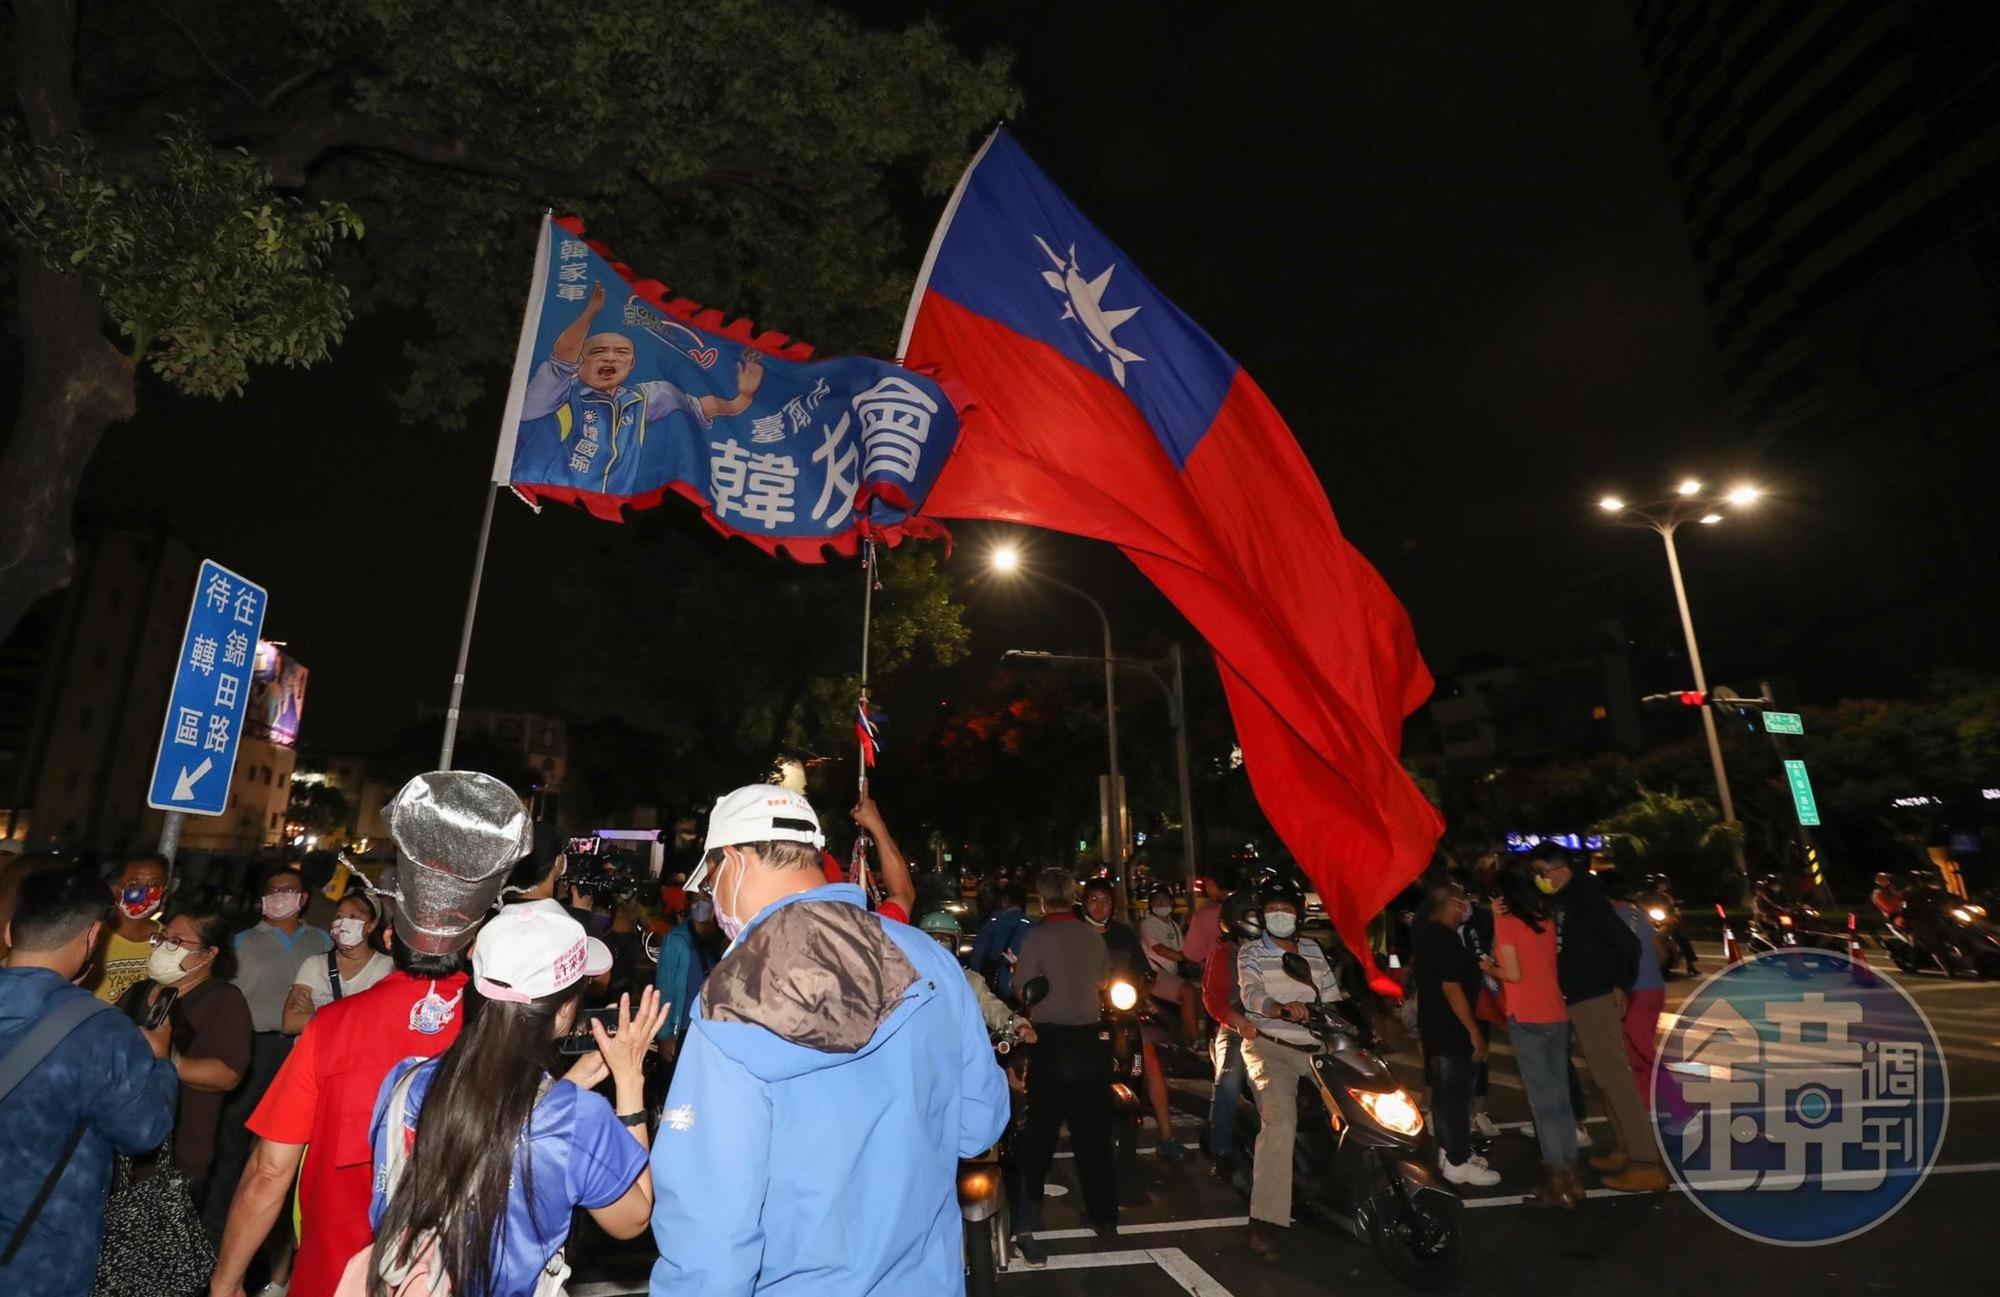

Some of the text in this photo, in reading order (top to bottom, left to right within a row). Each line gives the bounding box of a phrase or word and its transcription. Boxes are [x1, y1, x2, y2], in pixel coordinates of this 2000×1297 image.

[556, 240, 588, 301] 韓家軍
[569, 423, 599, 474] 韓國瑜
[174, 573, 232, 746] 待轉區
[203, 587, 257, 753] 往錦田路
